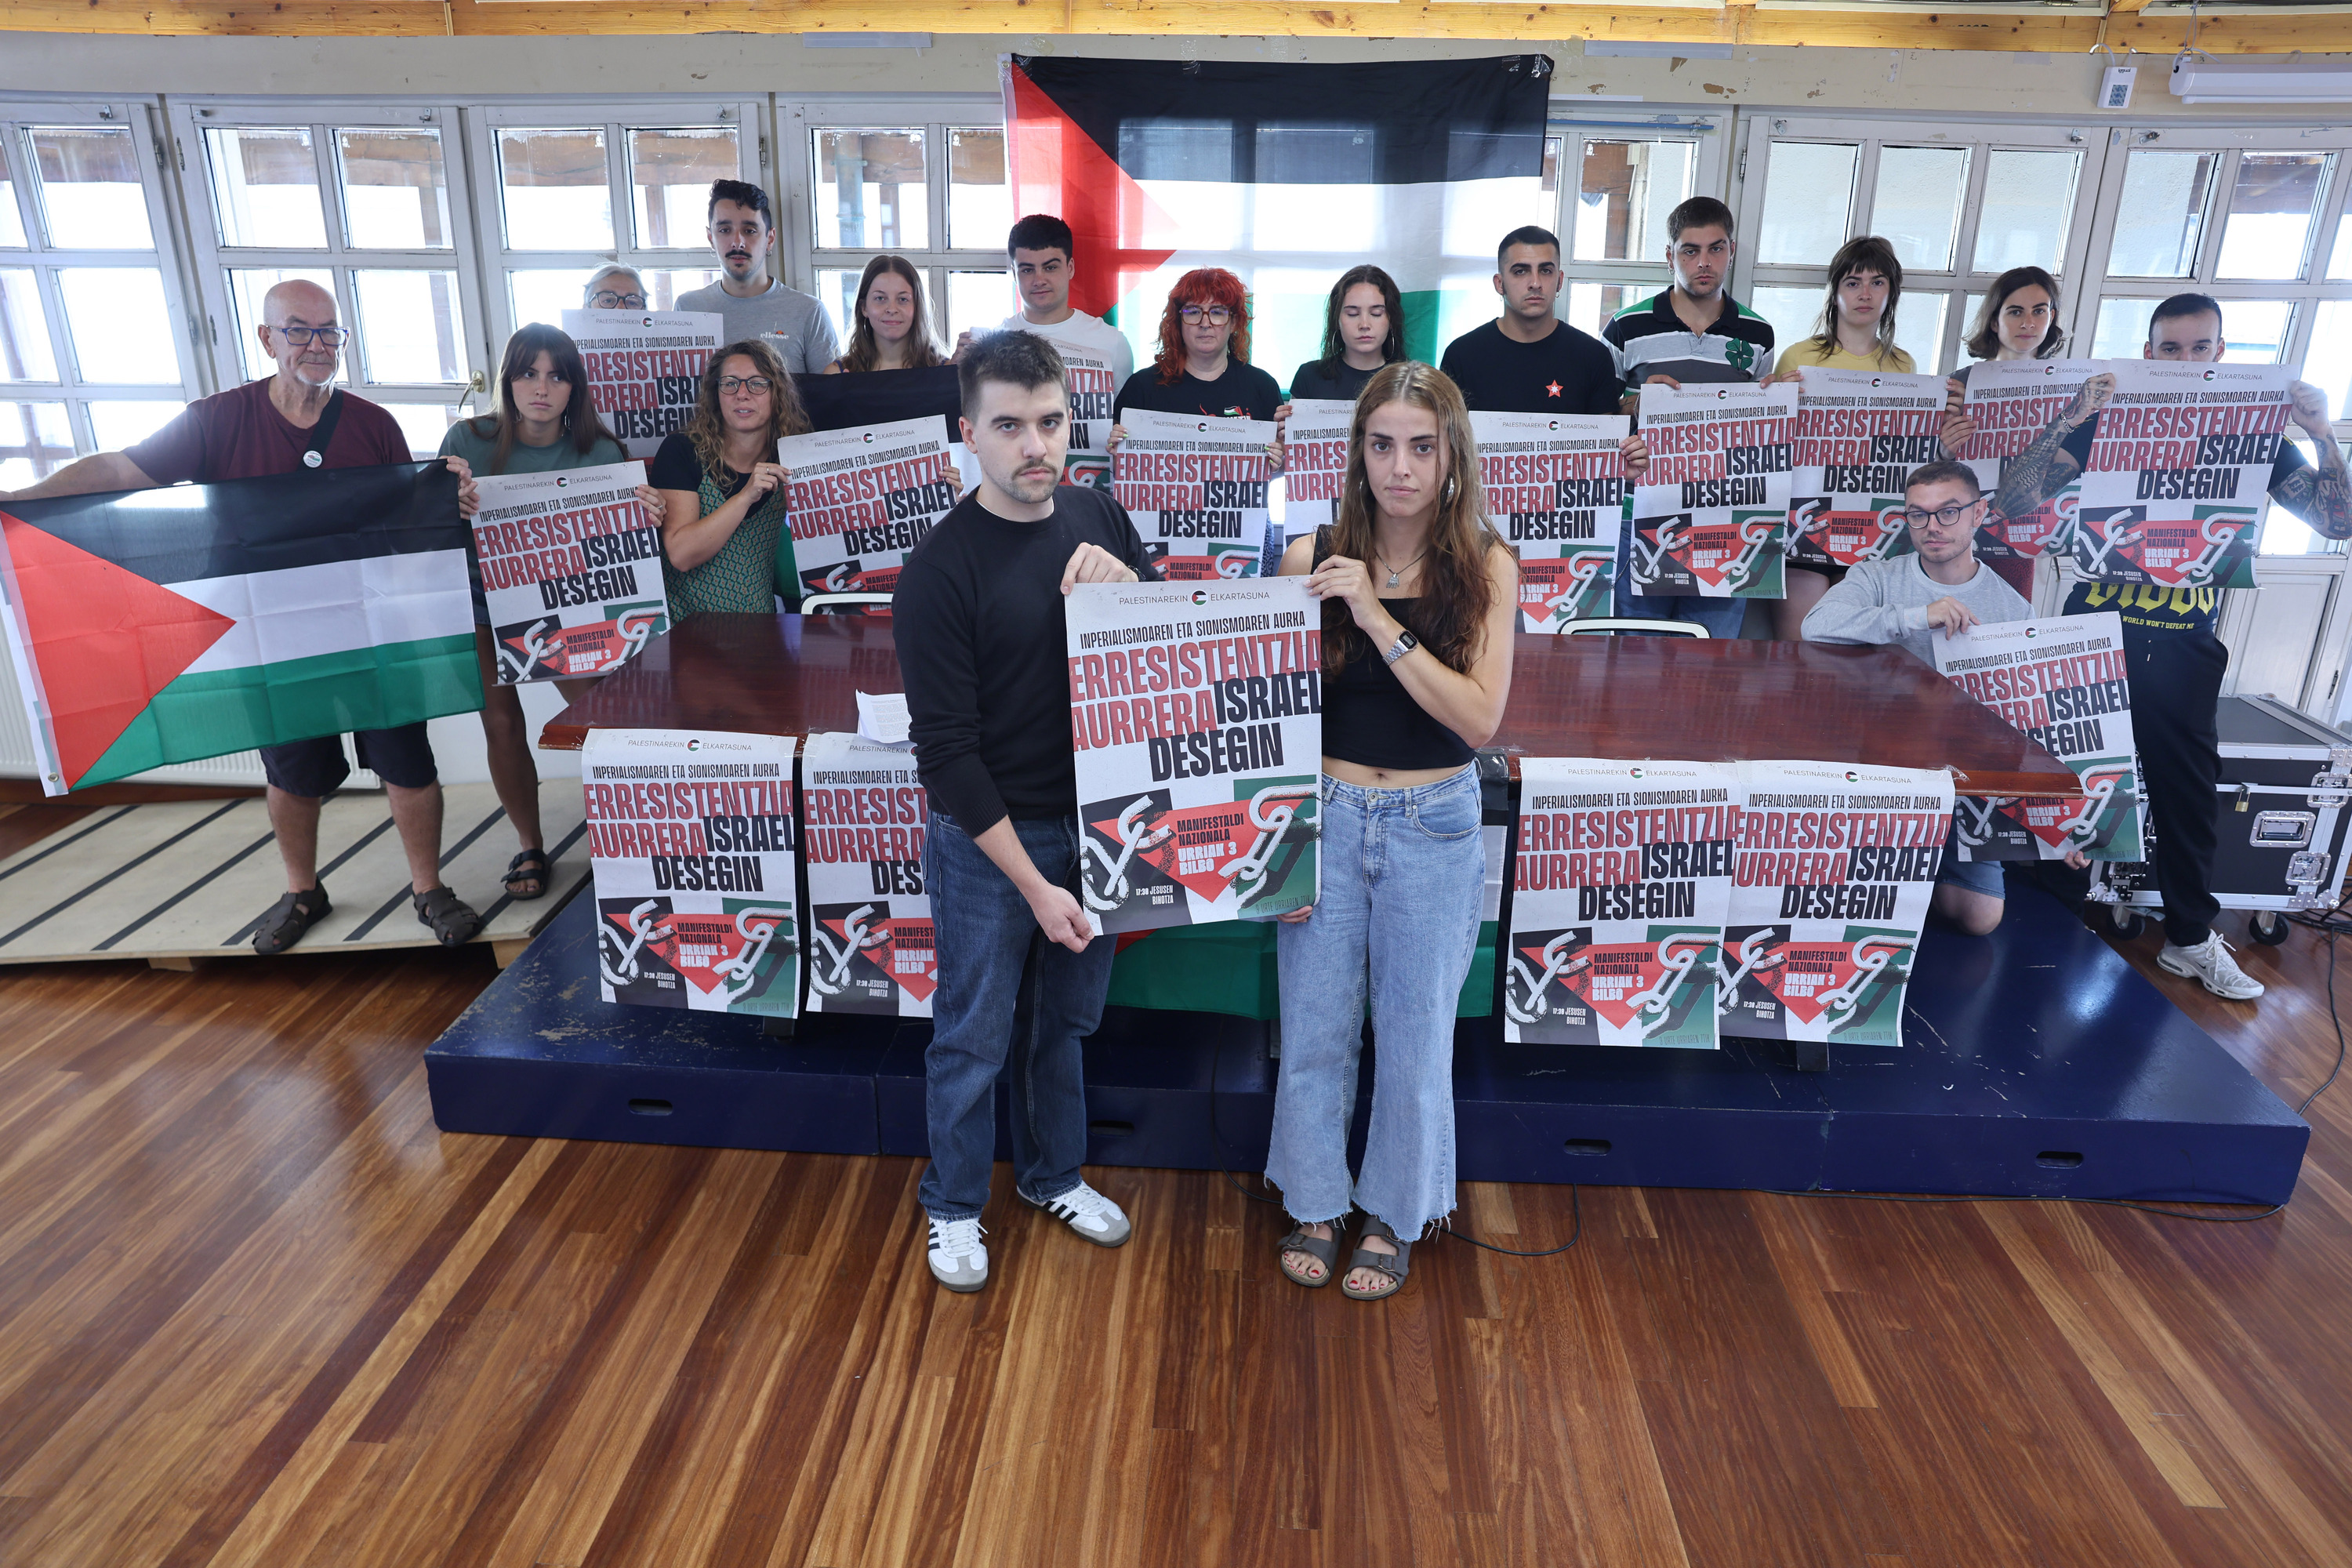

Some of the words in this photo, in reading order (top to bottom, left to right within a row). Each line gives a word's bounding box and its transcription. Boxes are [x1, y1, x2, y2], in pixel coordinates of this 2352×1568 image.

[633, 338, 643, 348] ETA
[645, 336, 692, 347] SIONISMOAREN
[695, 336, 716, 346] AURKA
[760, 331, 789, 339] ellesse
[1973, 386, 2030, 399] INPERIALISMOAREN
[2031, 385, 2041, 395] ETA
[2112, 393, 2183, 404] INPERIALISMOAREN
[2184, 393, 2198, 404] ETA
[2199, 391, 2257, 403] SIONISMOAREN
[2259, 390, 2285, 401] AURKA
[1799, 397, 1856, 406] INPERIALISMOAREN
[1857, 397, 1867, 407] ETA
[1869, 397, 1915, 407] SIONISMOAREN
[1916, 397, 1936, 408] AURKA
[1647, 411, 1704, 425] INPERIALISMOAREN
[1706, 410, 1715, 420] ETA
[1719, 407, 1764, 419] SIONISMOAREN
[1767, 405, 1787, 416] AURKA
[1153, 420, 1196, 430] PALESTINAREKIN
[1126, 440, 1184, 451] INPERIALISMOAREN
[1186, 441, 1196, 452] ETA
[1198, 441, 1243, 452] SIONISMOAREN
[1537, 441, 1547, 452] ETA
[1549, 440, 1596, 451] SIONISMOAREN
[2194, 434, 2280, 465] ISRAEL
[855, 455, 867, 467] ETA
[867, 445, 917, 464] SIONISMOAREN
[1726, 444, 1792, 476] ISRAEL
[504, 481, 554, 491] PALESTINAREKIN
[570, 474, 612, 484] ELKARTASUNA
[1824, 465, 1908, 494] DESEGIN
[2136, 468, 2241, 499] DESEGIN
[1682, 476, 1766, 509] DESEGIN
[480, 501, 547, 522] INPERIALISMOAREN
[549, 499, 561, 511] ETA
[562, 490, 615, 509] SIONISMOAREN
[1159, 510, 1243, 538] DESEGIN
[1510, 510, 1596, 541] DESEGIN
[1693, 532, 1737, 541] MANIFESTALDI
[580, 527, 661, 569] ISRAEL
[1693, 550, 1722, 560] URRIAK
[1725, 550, 1730, 558] 3
[1693, 559, 1715, 568] BILBO
[539, 564, 638, 611] DESEGIN
[1119, 595, 1188, 605] PALESTINAREKIN
[1210, 592, 1270, 601] ELKARTASUNA
[2122, 615, 2144, 625] WORLD
[2146, 619, 2165, 628] WON'T
[566, 629, 615, 644] MANIFESTALDI
[1080, 624, 1174, 649] INPERIALISMOAREN
[1178, 622, 1193, 639] ETA
[1196, 615, 1270, 637] SIONISMOAREN
[1273, 611, 1305, 628] AURKA
[1972, 631, 2023, 641] PALESTINAREKIN
[1946, 652, 2013, 673] INPERIALISMOAREN
[2016, 650, 2027, 662] ETA
[2030, 641, 2086, 660] SIONISMOAREN
[2086, 637, 2112, 651] AURKA
[1214, 670, 1322, 724] ISRAEL
[2045, 679, 2132, 721] ISRAEL
[1149, 723, 1284, 782] DESEGIN
[593, 766, 669, 779] INPERIALISMOAREN
[673, 765, 685, 778] ETA
[688, 764, 750, 778] SIONISMOAREN
[753, 764, 780, 777] AURKA
[814, 771, 892, 784] INPERIALISMOAREN
[895, 771, 909, 783] ETA
[1784, 770, 1842, 779] PALESTINAREKIN
[1861, 775, 1911, 783] ELKARTASUNA
[1533, 793, 1613, 810] INPERIALISMOAREN
[1617, 793, 1630, 806] ETA
[1634, 790, 1697, 805] SIONISMOAREN
[1700, 789, 1728, 802] AURKA
[1749, 794, 1829, 808] INPERIALISMOAREN
[1831, 795, 1846, 808] ETA
[1847, 796, 1911, 809] SIONISMOAREN
[1913, 797, 1941, 810] AURKA
[1177, 813, 1244, 833] MANIFESTALDI
[703, 815, 795, 852] ISRAEL
[1178, 829, 1230, 846] NAZIONALA
[1178, 843, 1225, 862] URRIAK
[1229, 841, 1237, 855] 3
[1179, 858, 1214, 876] BILBO
[1641, 840, 1733, 879] ISRAEL
[1846, 846, 1940, 883] ISRAEL
[652, 856, 764, 891] DESEGIN
[1149, 885, 1173, 895] JESUSEN
[1152, 895, 1174, 905] BIHOTZA
[1579, 881, 1697, 921] DESEGIN
[1780, 884, 1899, 920] DESEGIN
[677, 923, 733, 933] MANIFESTALDI
[679, 934, 722, 944] NAZIONALA
[679, 944, 718, 956] URRIAK
[720, 945, 728, 956] 3
[1789, 950, 1848, 961] MANIFESTALDI
[680, 956, 710, 967] BILBO
[1594, 953, 1653, 964] MANIFESTALDI
[895, 963, 925, 974] BILBO
[1594, 964, 1639, 975] NAZIONALA
[1788, 962, 1833, 973] NAZIONALA
[1592, 976, 1633, 989] URRIAK
[1636, 976, 1644, 987] 3
[1784, 974, 1825, 985] URRIAK
[1828, 975, 1836, 985] 3
[1592, 989, 1623, 1000] BILBO
[1783, 985, 1814, 996] BILBO
